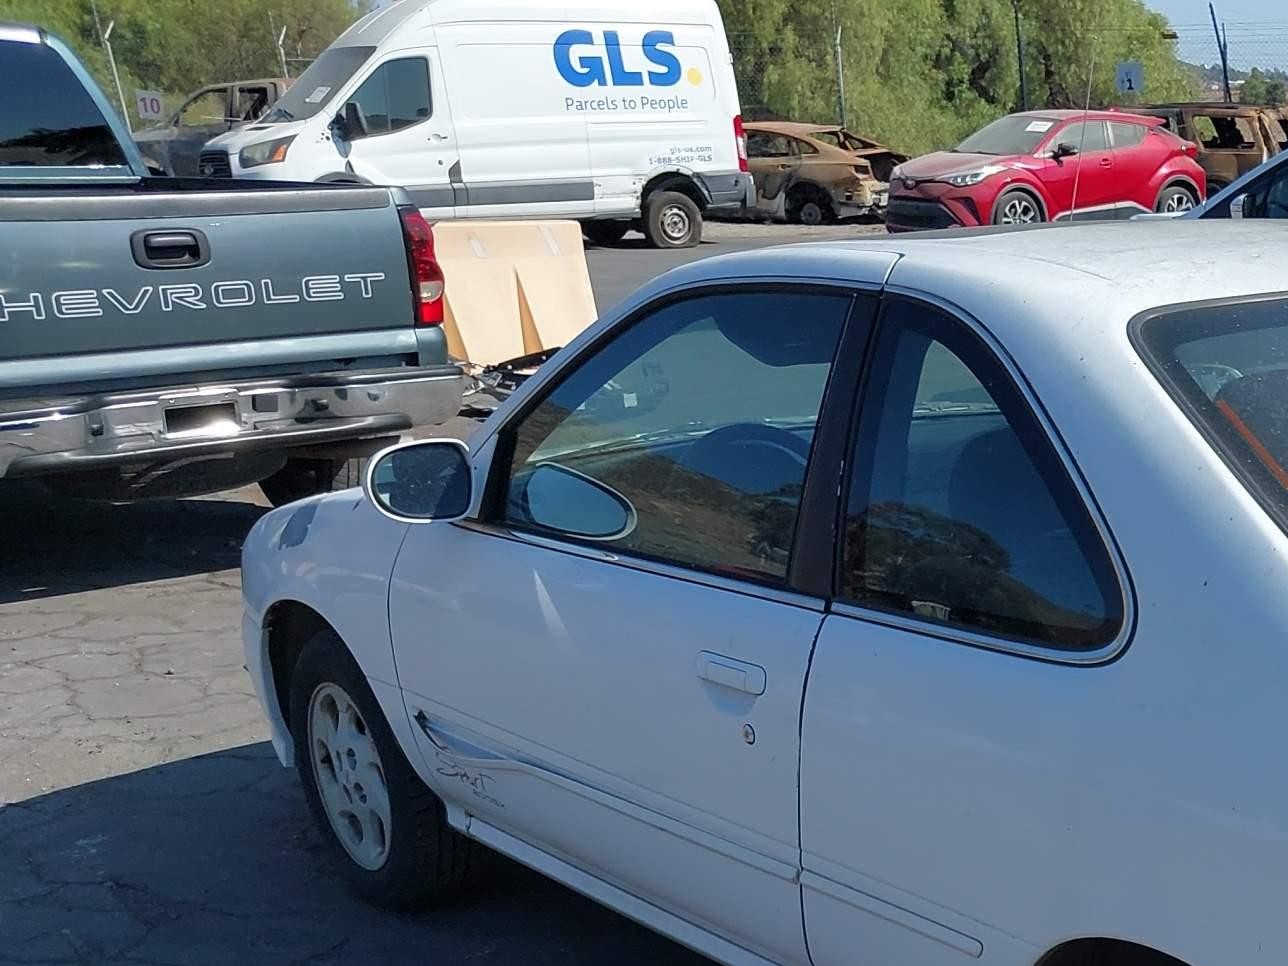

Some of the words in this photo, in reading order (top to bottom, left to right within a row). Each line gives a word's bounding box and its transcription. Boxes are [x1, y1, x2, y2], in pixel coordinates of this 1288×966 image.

[553, 29, 682, 88] GLS
[1126, 78, 1135, 91] 1
[139, 97, 161, 114] 10
[564, 96, 618, 111] Parcels
[622, 97, 637, 110] to
[640, 95, 688, 113] People
